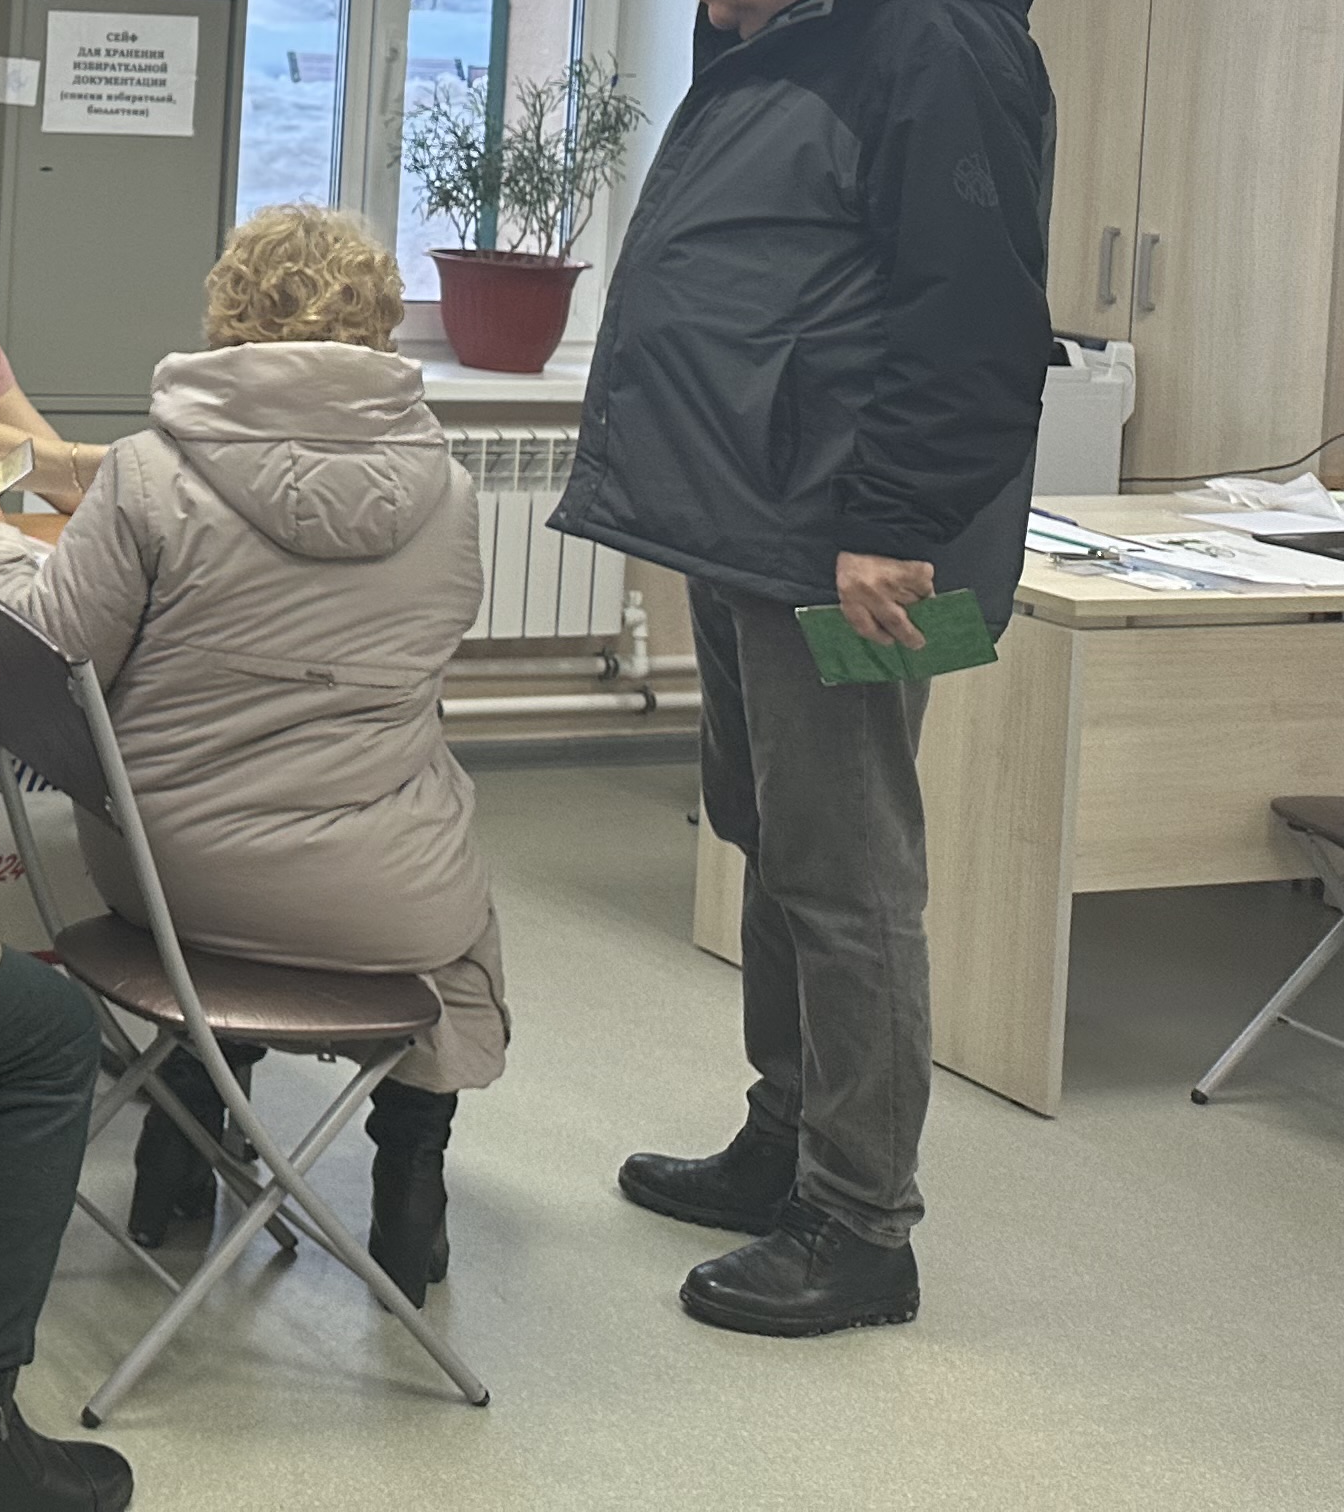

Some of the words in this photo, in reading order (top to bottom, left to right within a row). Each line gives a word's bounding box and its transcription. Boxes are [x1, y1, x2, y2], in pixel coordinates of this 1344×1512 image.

[106, 30, 138, 43] СЕЙФ
[77, 47, 101, 58] ДЛЯ
[104, 48, 165, 59] ХРАНЕНИЯ
[72, 75, 167, 87] ДОКУМЕНТАЦИИ
